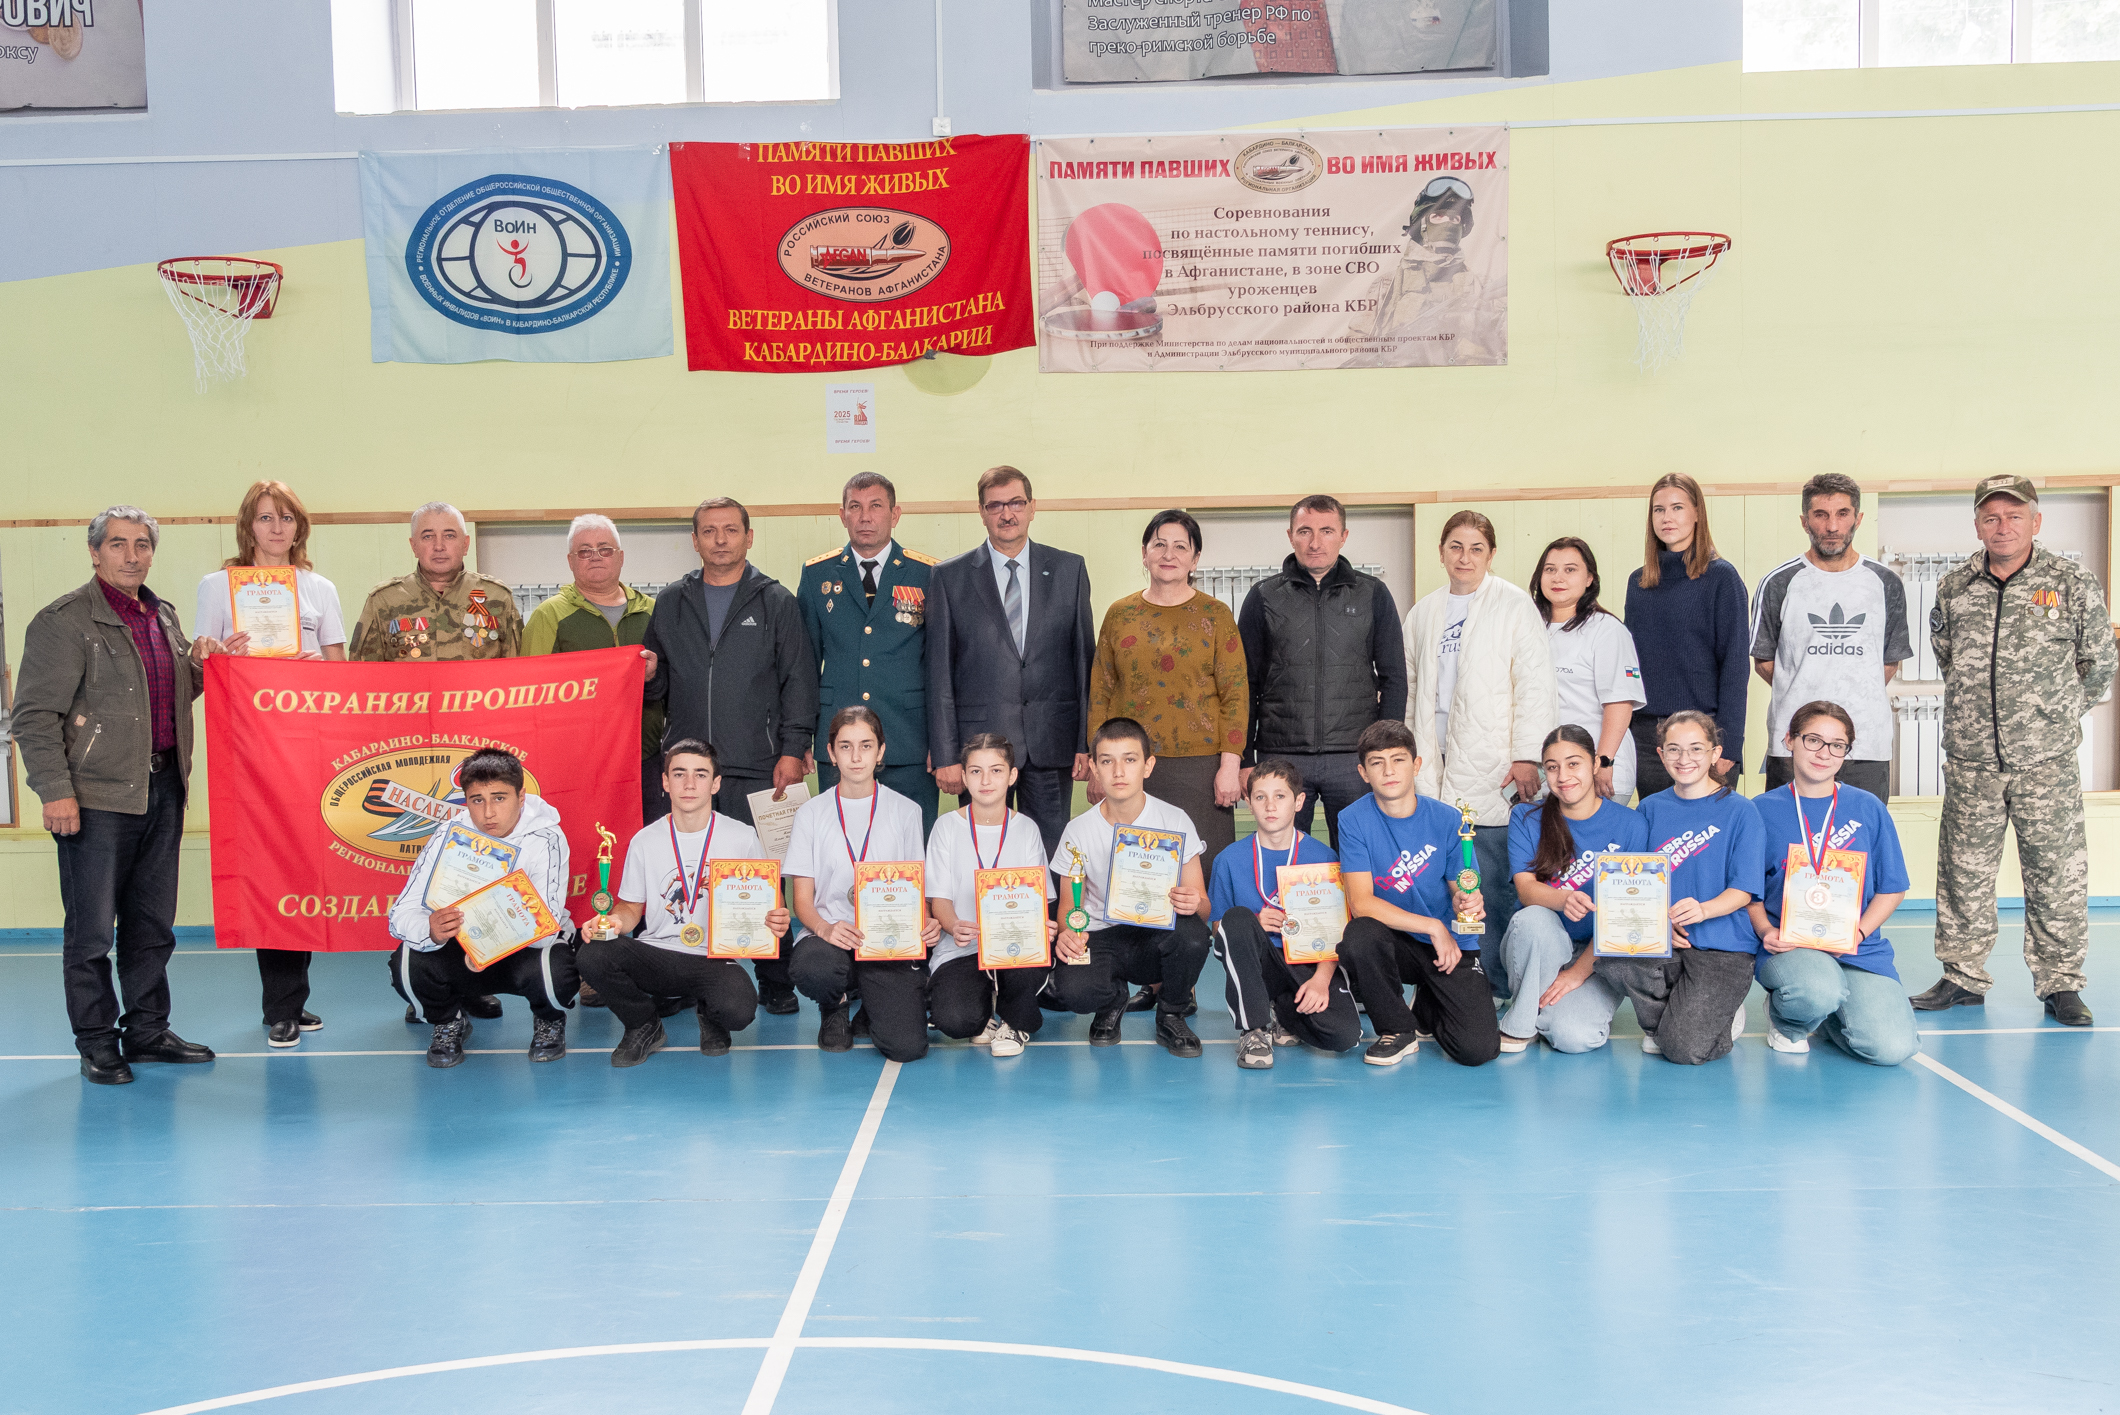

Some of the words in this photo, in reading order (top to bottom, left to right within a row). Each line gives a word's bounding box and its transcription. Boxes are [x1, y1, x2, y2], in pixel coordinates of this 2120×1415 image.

[0, 0, 94, 27] ОВИЧ
[1088, 12, 1201, 34] Заслуженный
[1204, 7, 1262, 29] тренер
[1265, 5, 1288, 21] РФ
[1291, 8, 1311, 22] по
[1088, 33, 1213, 57] греко-римской
[1217, 28, 1276, 48] борьбе
[757, 142, 853, 163] ПАМЯТИ
[856, 137, 957, 162] ПАВШИХ
[1049, 160, 1134, 180] ПАМЯТИ
[1140, 159, 1231, 179] ПАВШИХ
[1327, 156, 1355, 175] ВО
[1361, 154, 1407, 174] ИМЯ
[1413, 151, 1498, 172] ЖИВЫХ
[770, 174, 801, 196] ВО
[805, 173, 857, 195] ИМЯ
[860, 167, 950, 195] ЖИВЫХ
[416, 213, 441, 263] РЕГИОНАЛЬНОЕ
[439, 191, 476, 216] ОТДЕЛЕНИЕ
[475, 181, 540, 195] ОБЩЕРОССИЙСКОЙ
[541, 186, 595, 214] ОБЩЕСТВЕННОЙ
[593, 211, 622, 257] ОРГАНИЗАЦИИ
[1213, 207, 1331, 222] Соревнования
[784, 212, 850, 257] РОССИЙСКИЙ
[856, 213, 890, 224] СОЮЗ
[1171, 229, 1190, 240] по
[1194, 227, 1299, 241] настольному
[1303, 225, 1374, 239] теннису,
[1143, 245, 1254, 261] посвящённые
[1258, 246, 1317, 258] памяти
[1321, 242, 1402, 256] погибших
[804, 273, 872, 296] ВЕТЕРАНОВ
[878, 245, 947, 296] АФГАНИСТАНА
[1165, 268, 1173, 278] в
[1177, 265, 1288, 281] Афганистане,
[1292, 266, 1301, 276] в
[1305, 265, 1342, 275] зоне
[1345, 261, 1380, 274] СВО
[419, 274, 444, 304] ВОЕННЫХ
[443, 300, 479, 321] ИНВАЛИДОВ
[512, 302, 594, 328] КАБАРДИНО-БАЛКАРСКОЙ
[592, 268, 619, 306] РЕСПУБЛИКЕ
[1228, 284, 1317, 299] уроженцев
[727, 309, 844, 331] ВЕТЕРАНЫ
[846, 290, 1006, 331] АФГАНИСТАНА
[1167, 303, 1279, 319] Эльбрусского
[1283, 301, 1340, 317] района
[1345, 299, 1378, 312] КБР
[743, 325, 993, 366] КАБАРДИНО-БАЛКАРИИ
[1090, 340, 1107, 349] При
[1108, 340, 1154, 349] поддержке
[1156, 339, 1215, 349] Министерства
[1216, 340, 1226, 348] по
[1228, 340, 1253, 348] делам
[1254, 336, 1326, 348] национальностей
[1334, 335, 1396, 345] общественным
[1397, 335, 1437, 344] проектам
[1439, 333, 1455, 341] КБР
[1154, 350, 1220, 360] Администрации
[1221, 348, 1278, 357] Эльбрусского
[1279, 347, 1348, 356] муниципального
[1350, 345, 1379, 355] района
[1381, 345, 1398, 353] КБР
[834, 410, 851, 418] 2025
[1807, 642, 1864, 656] adidas
[252, 688, 432, 714] СОХРАНЯЯ
[438, 677, 599, 713] ПРОШЛОЕ
[330, 733, 529, 772] КАБАРДИНО-БАЛКАРСКОЕ
[329, 761, 392, 807] ОБЩЕРОССИЙСКАЯ
[395, 755, 451, 768] МОЛОДЕЖНАЯ
[399, 843, 425, 855] ПАТР
[1127, 850, 1166, 862] ГРАМОТА
[1671, 824, 1721, 867] RUSSIA
[457, 850, 495, 870] ГРАМОТА
[1295, 888, 1332, 898] ГРАМОТА
[1393, 876, 1411, 893] IN
[506, 893, 531, 927] ГРАМОТА
